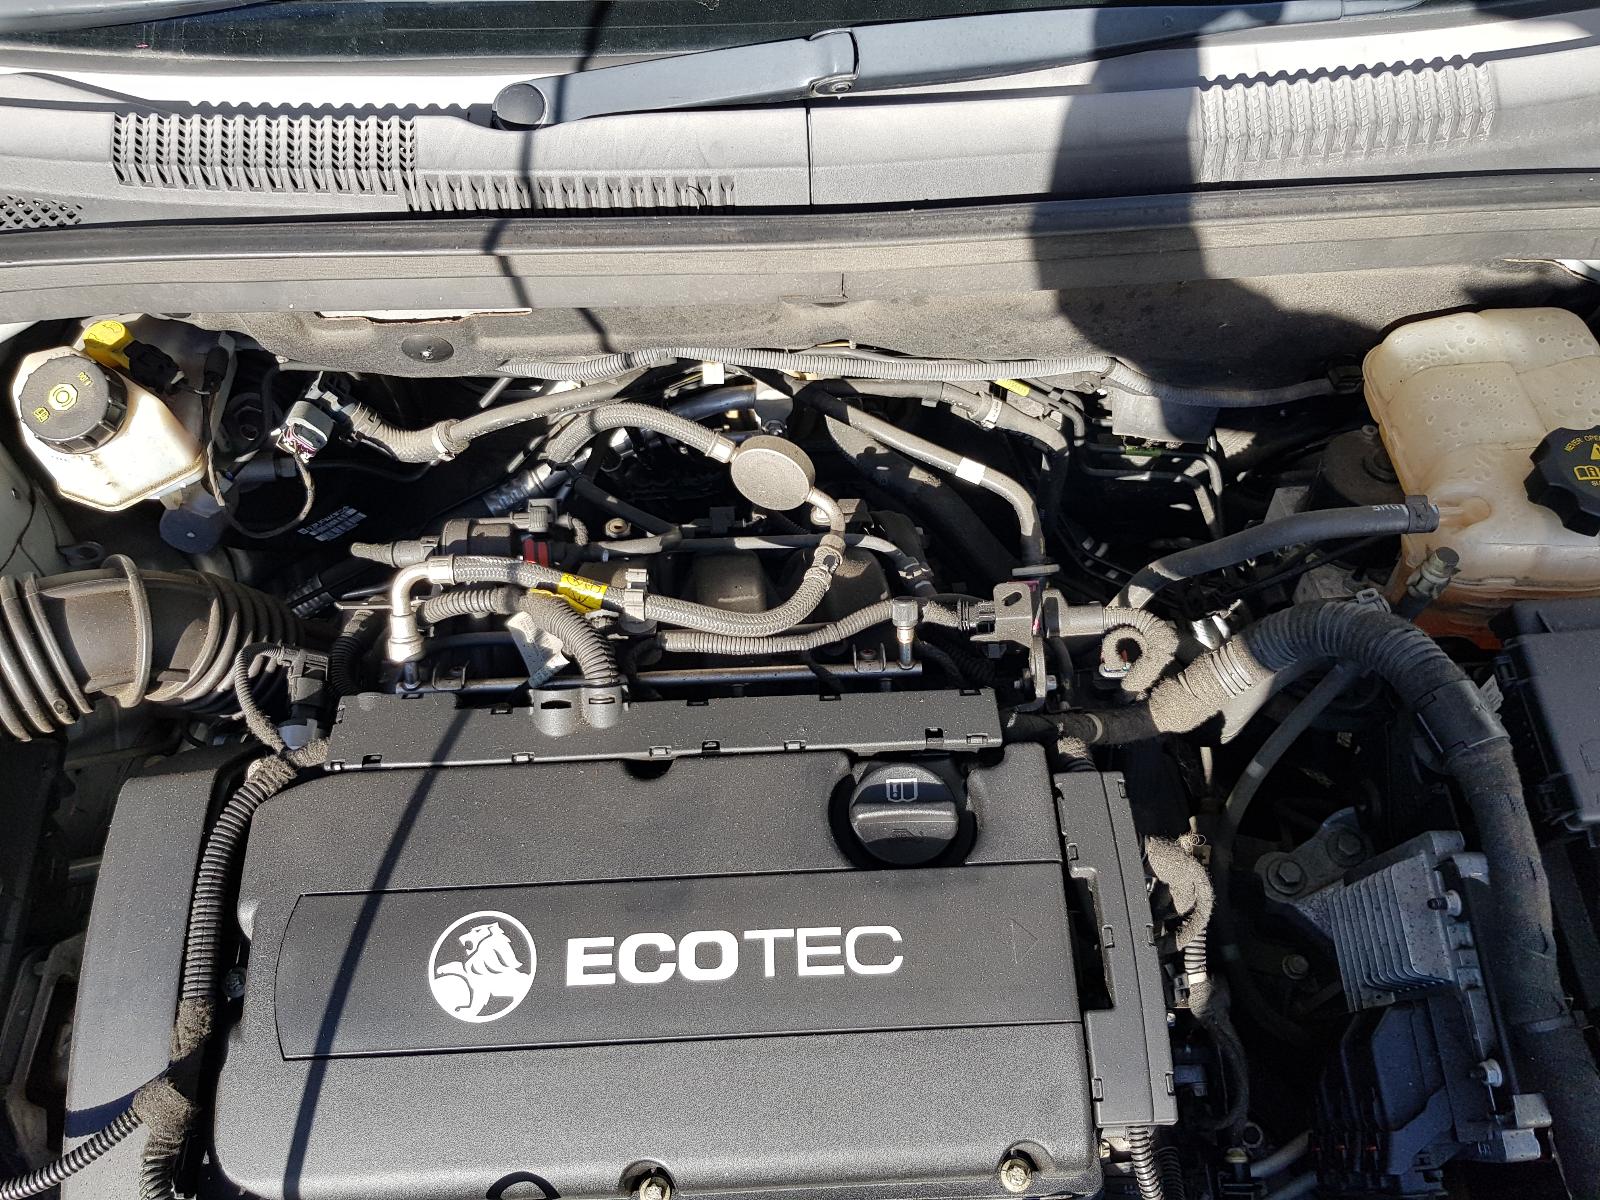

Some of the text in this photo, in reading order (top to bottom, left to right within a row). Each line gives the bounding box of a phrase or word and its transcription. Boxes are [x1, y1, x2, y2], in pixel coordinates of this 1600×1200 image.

[1563, 434, 1600, 452] NEVER OPE
[566, 925, 904, 986] ECOTEC
